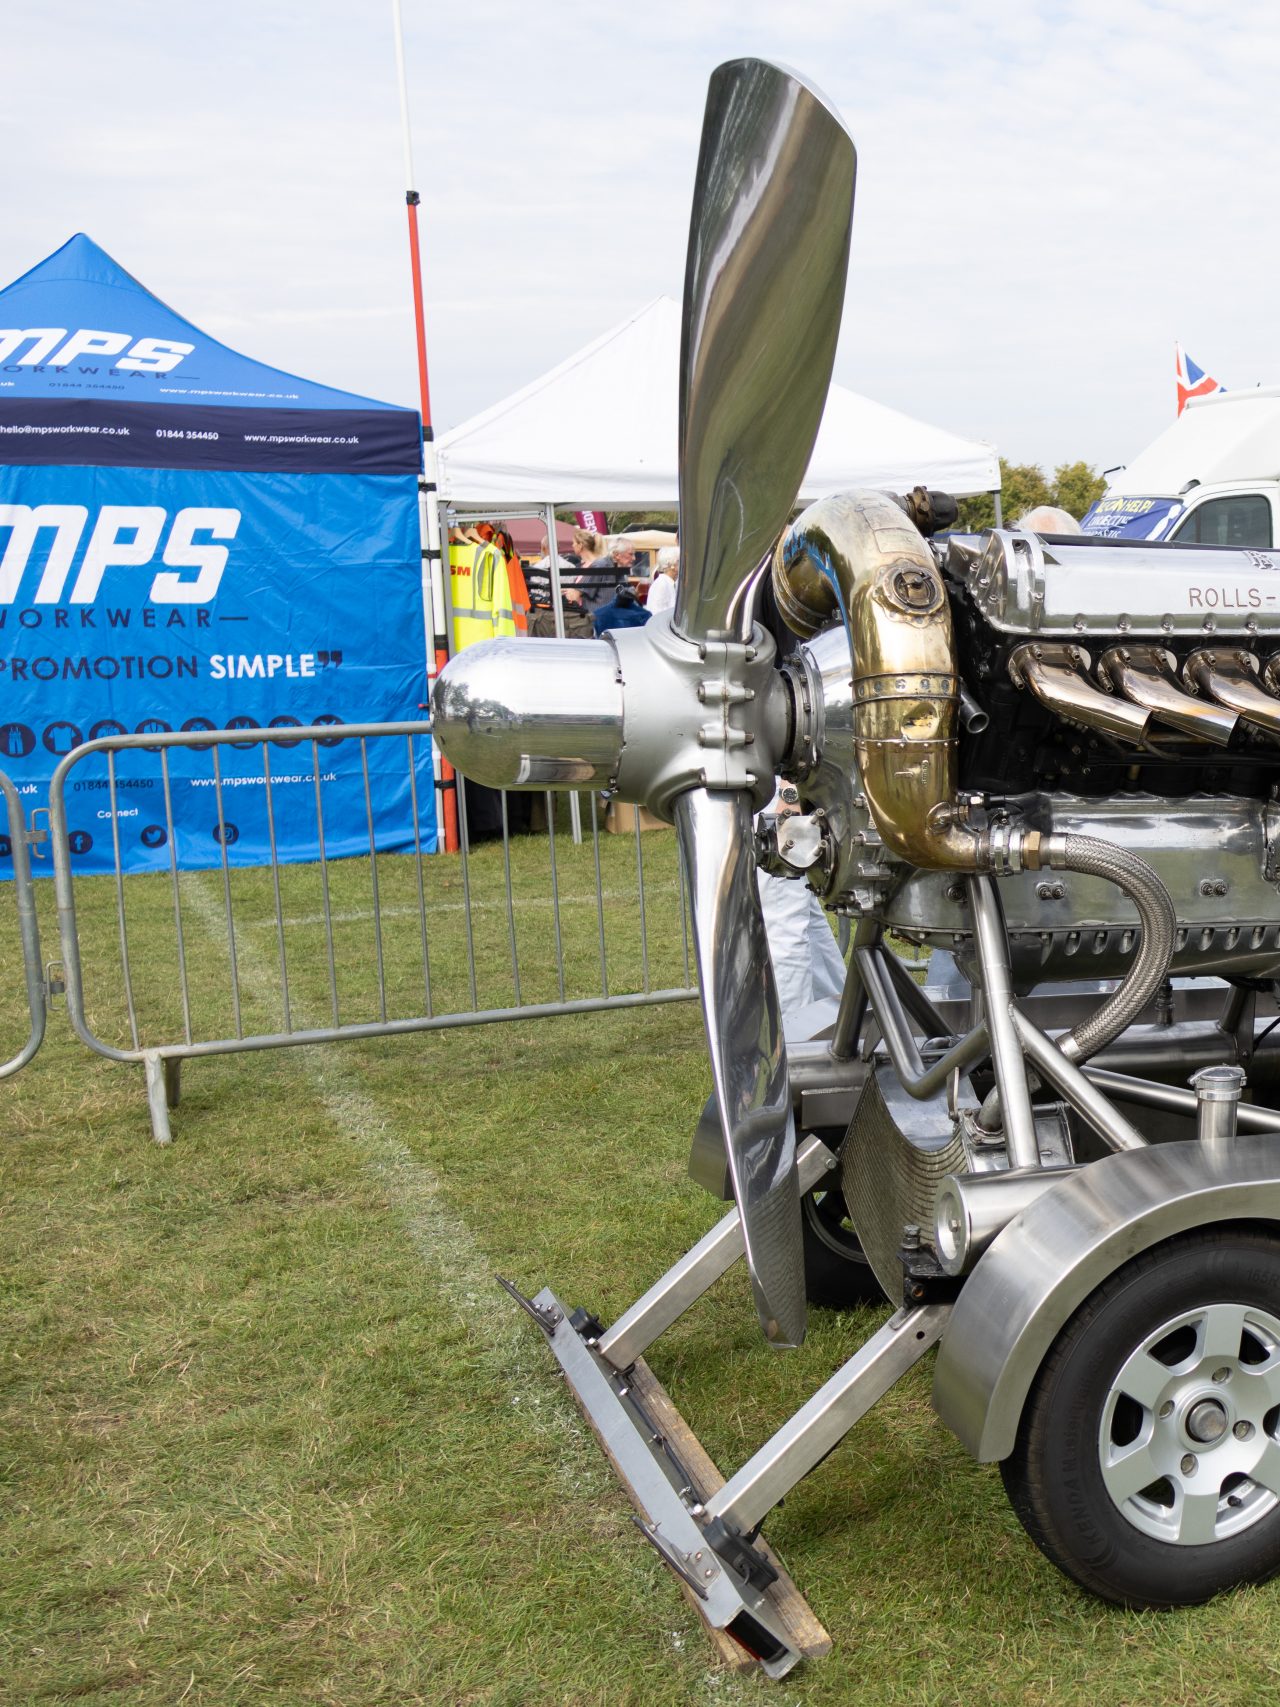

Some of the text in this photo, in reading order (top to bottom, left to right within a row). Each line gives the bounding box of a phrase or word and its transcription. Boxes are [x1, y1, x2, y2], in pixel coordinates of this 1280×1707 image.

[0, 425, 360, 445] hello@mpsworkwear.co.uk 01844 354450 www.mpsworkwear.co.uk
[73, 781, 108, 792] 01844
[97, 808, 139, 819] Conect
